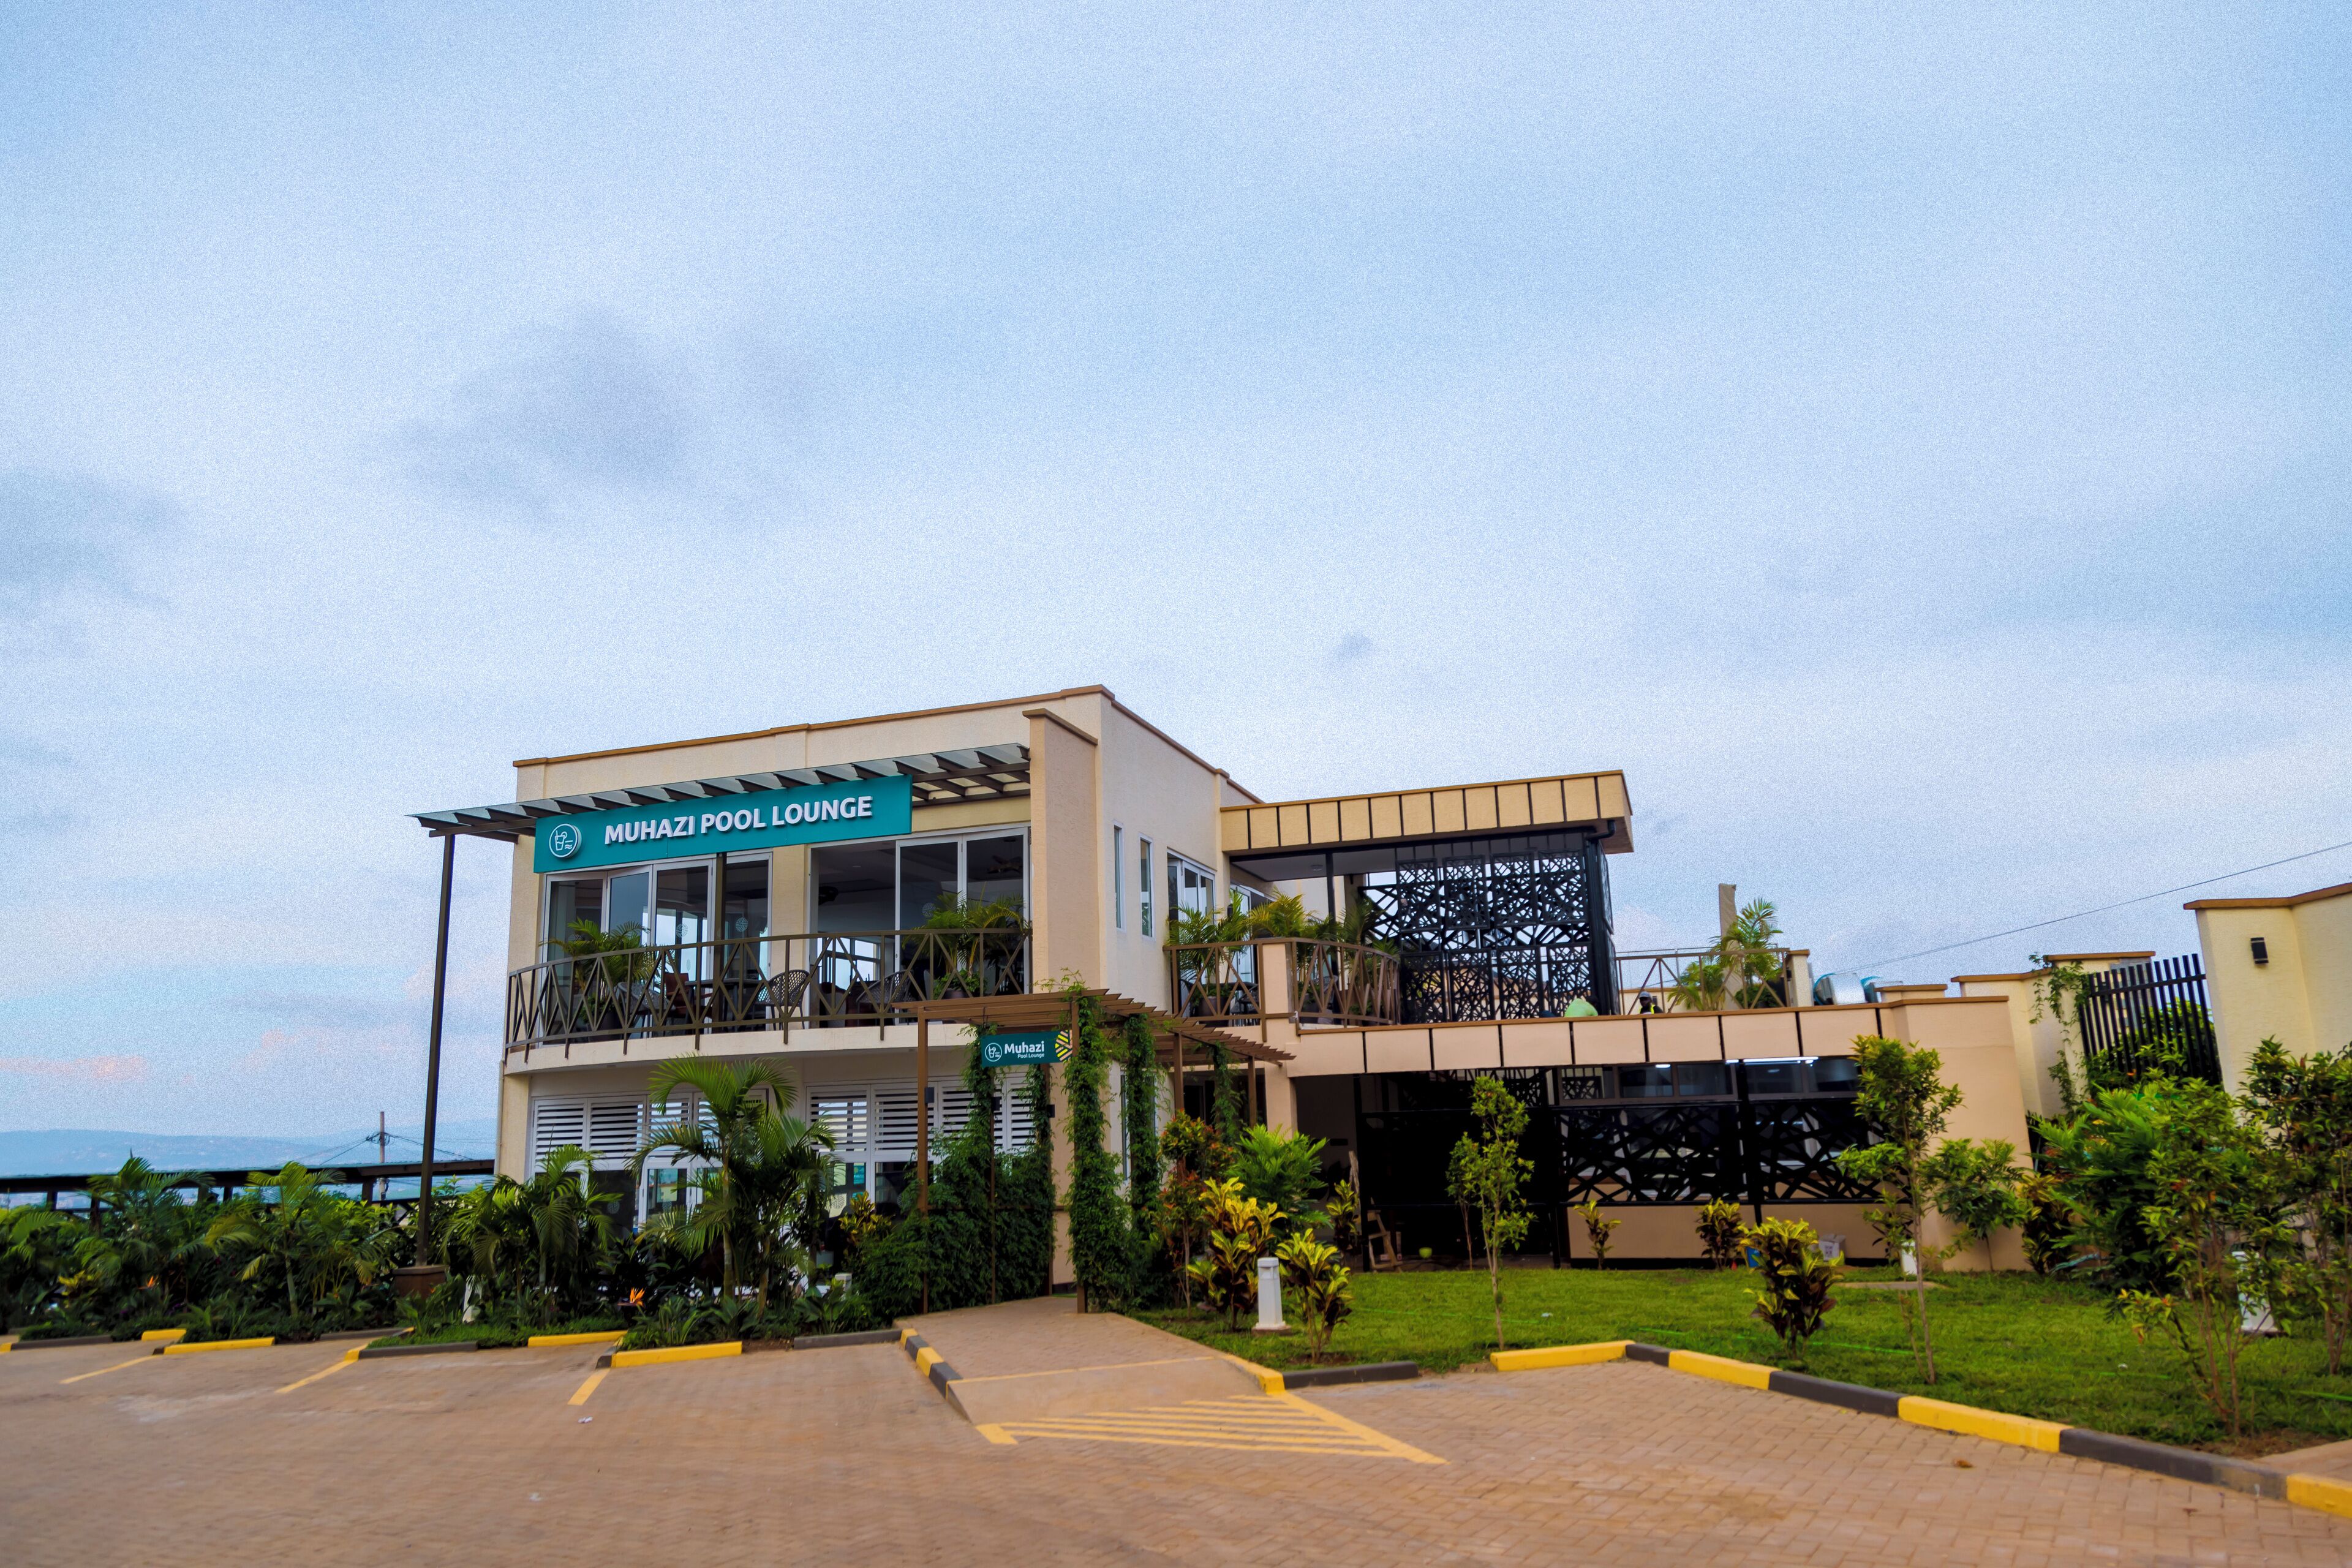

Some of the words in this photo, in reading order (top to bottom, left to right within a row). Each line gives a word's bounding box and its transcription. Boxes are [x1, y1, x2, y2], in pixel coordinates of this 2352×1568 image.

[605, 816, 694, 844] MUHAZI
[701, 809, 766, 834] POOL
[772, 796, 873, 826] LOUNGE
[1005, 1041, 1044, 1054] Muhazi
